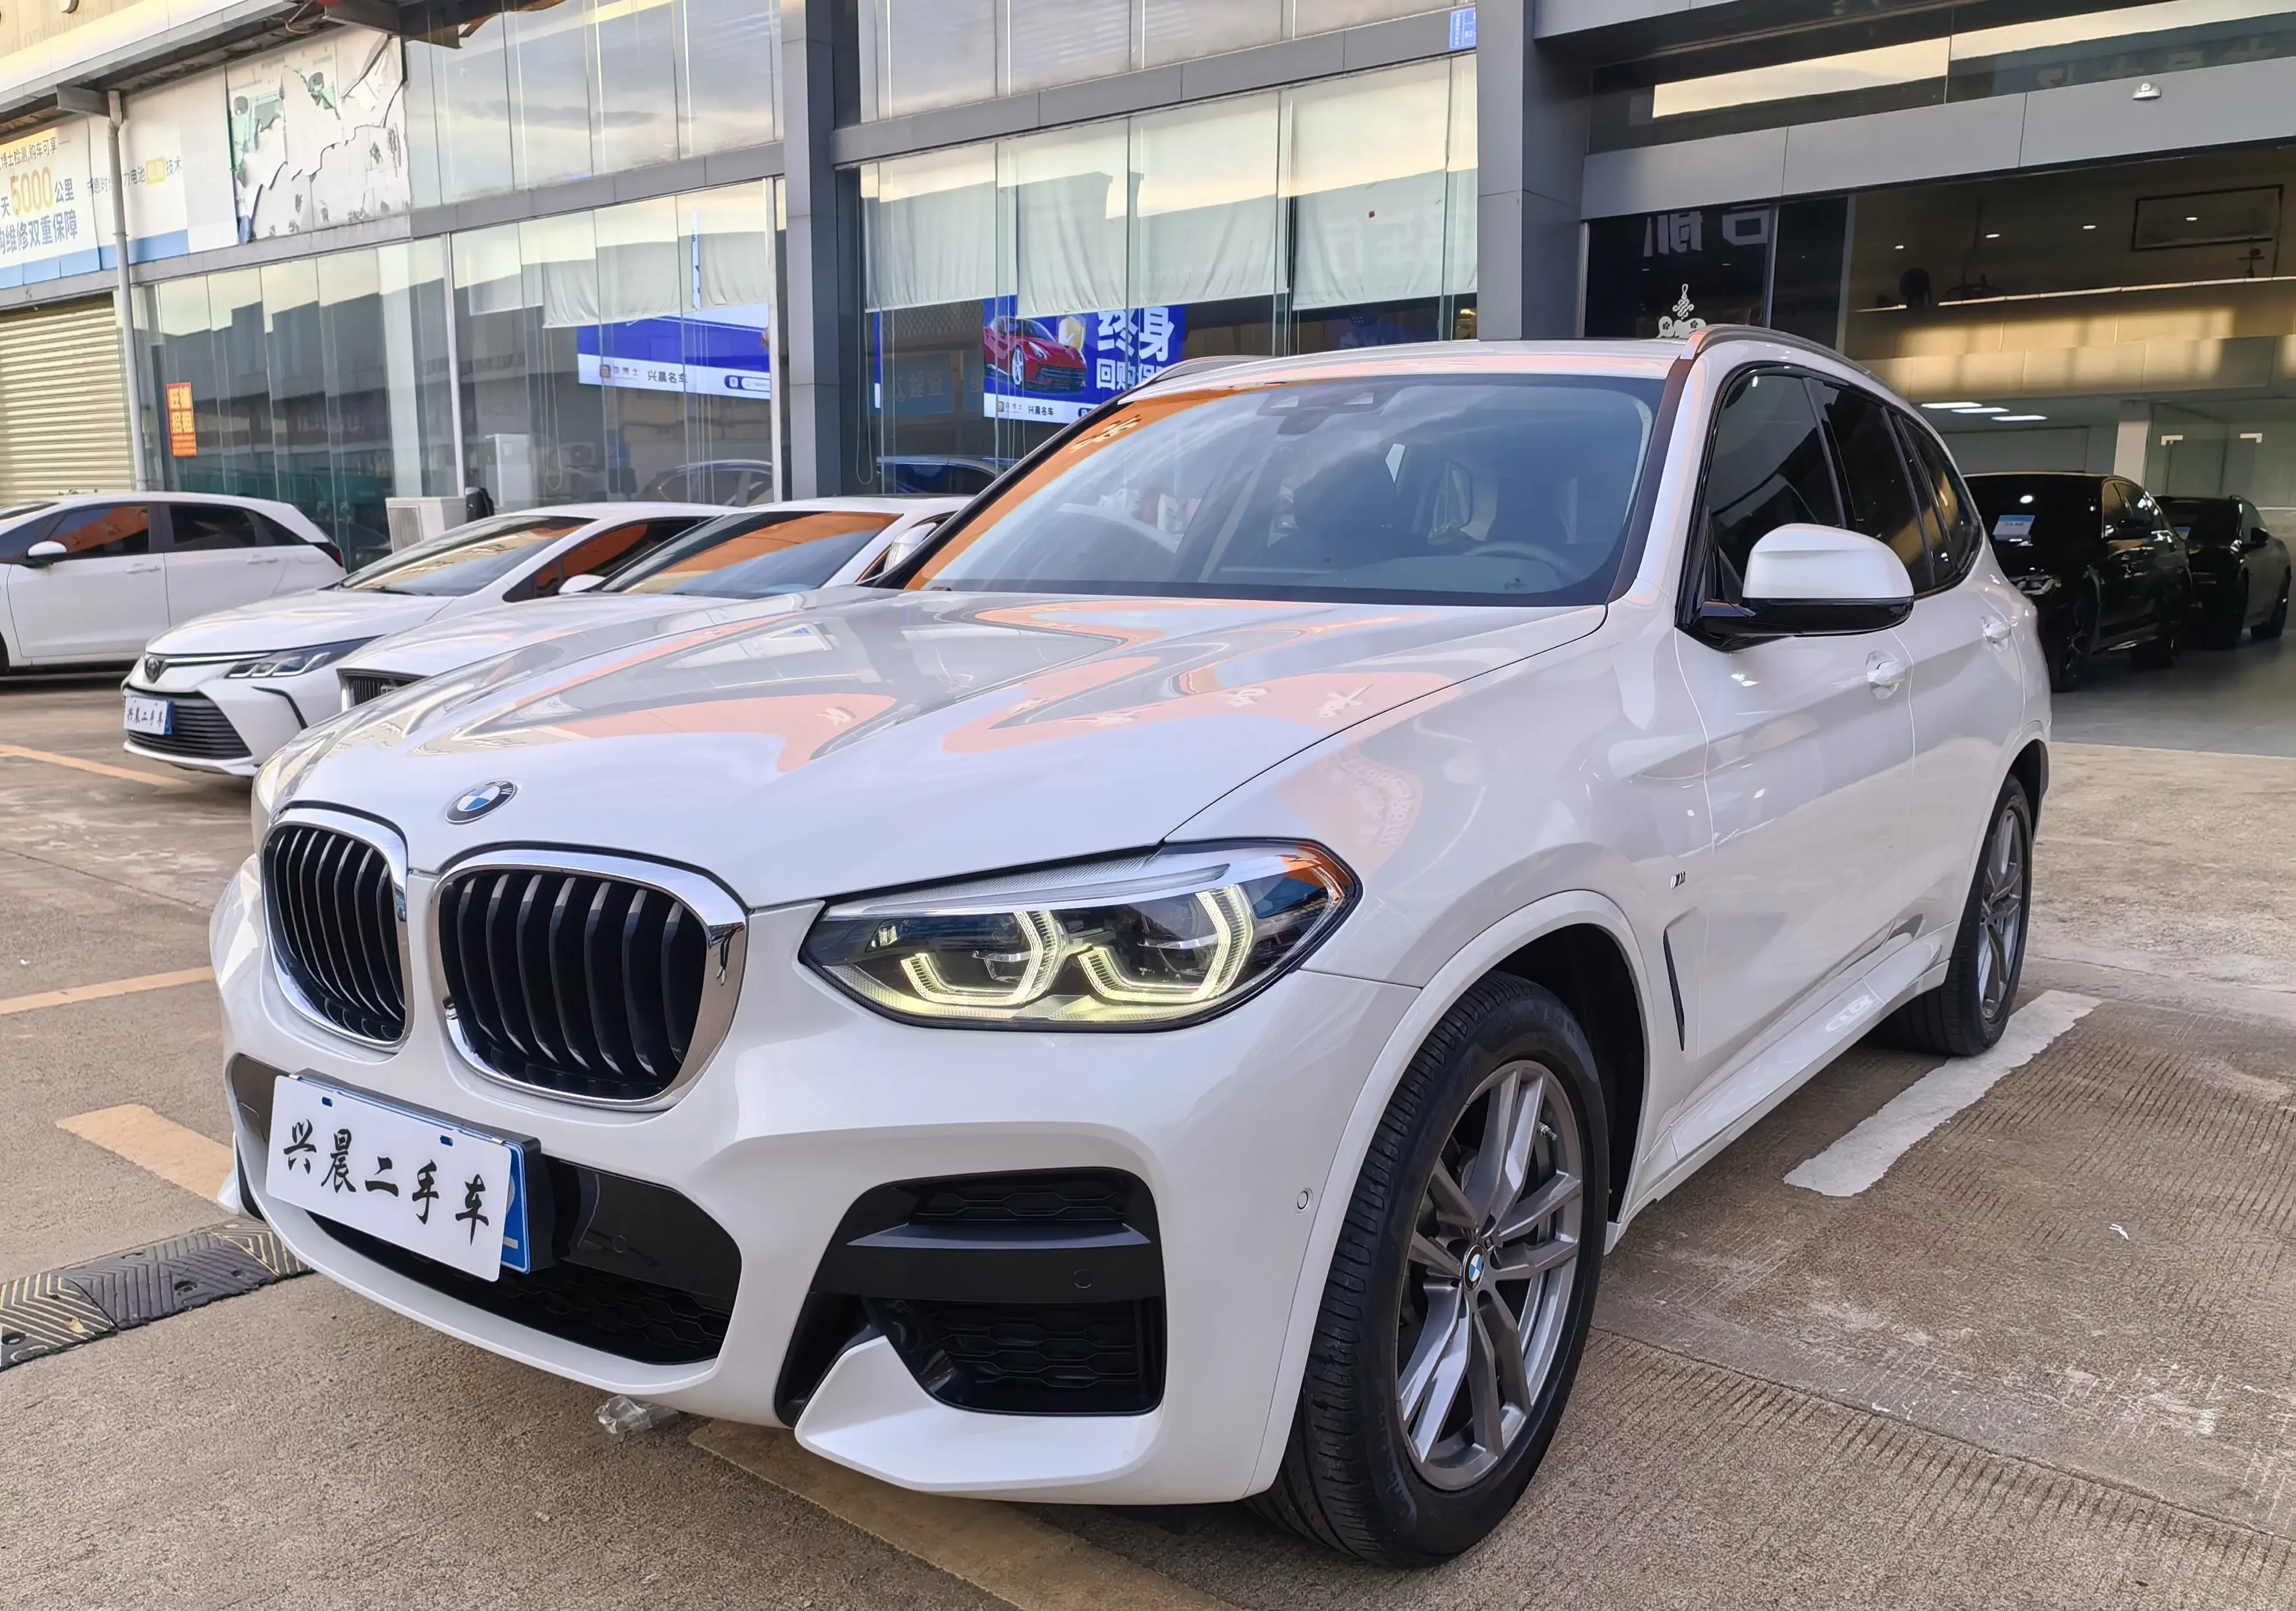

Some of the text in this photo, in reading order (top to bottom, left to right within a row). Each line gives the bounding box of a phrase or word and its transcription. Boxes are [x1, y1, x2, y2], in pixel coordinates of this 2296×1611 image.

[0, 137, 57, 168] 博士检测,购车可享
[1097, 307, 1175, 362] 终身
[1096, 358, 1163, 391] 回购保
[283, 1118, 489, 1247] 兴晨二手车
